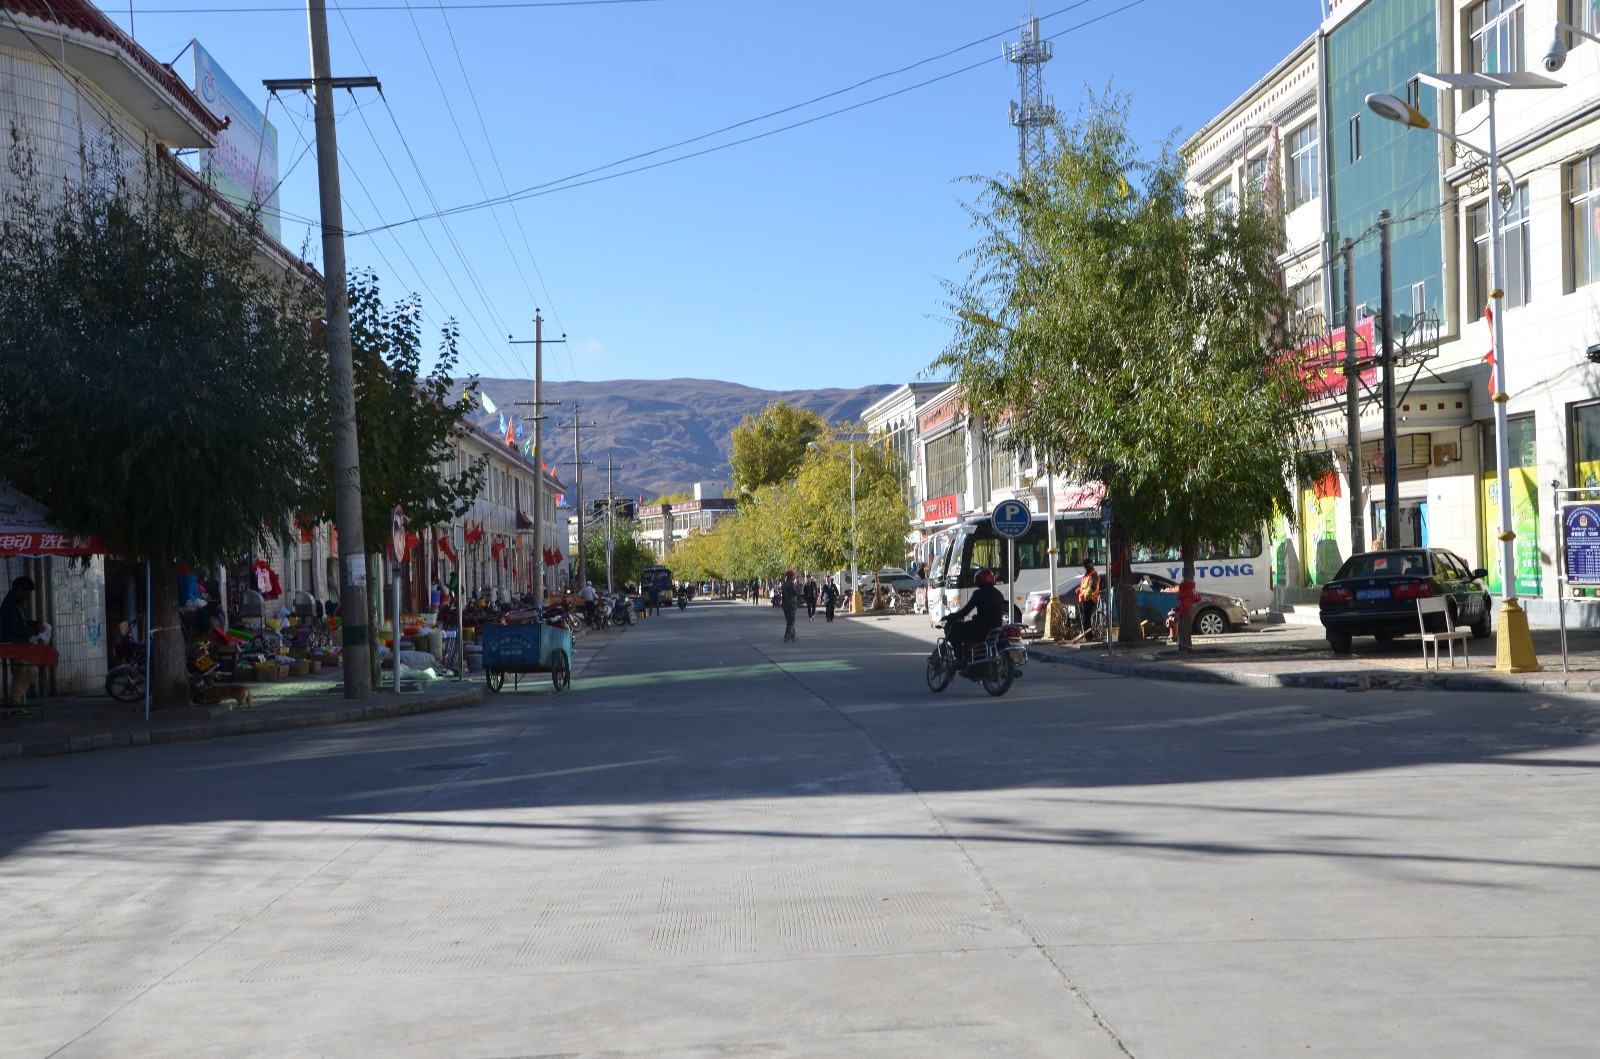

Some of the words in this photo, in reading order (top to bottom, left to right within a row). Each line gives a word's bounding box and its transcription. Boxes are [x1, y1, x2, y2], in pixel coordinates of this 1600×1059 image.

[1005, 505, 1019, 521] P
[0, 534, 33, 551] 电动
[1167, 563, 1254, 580] YTONG
